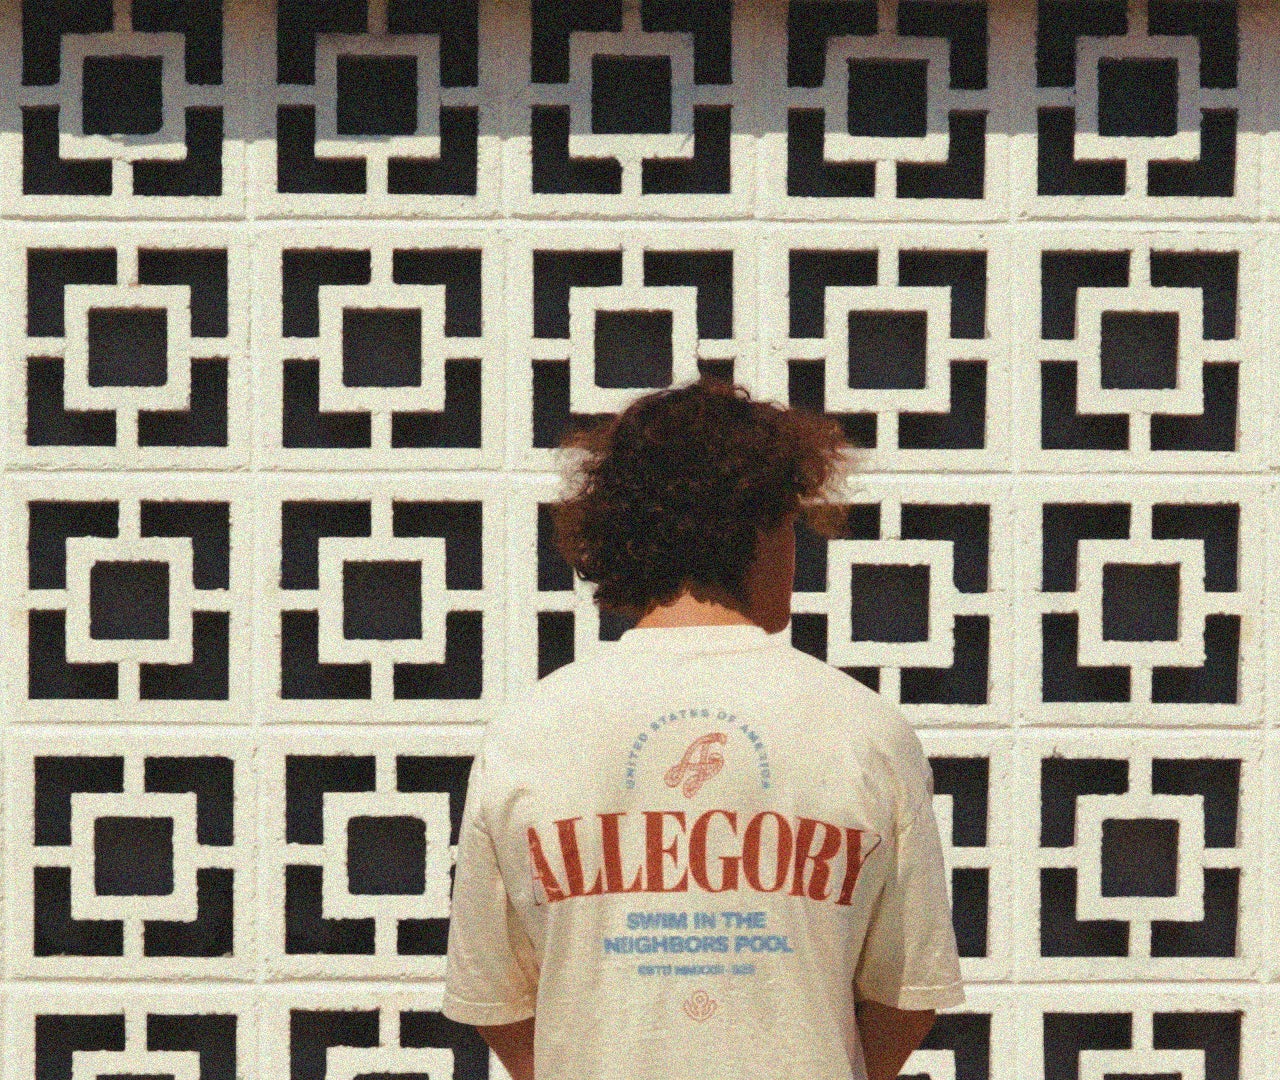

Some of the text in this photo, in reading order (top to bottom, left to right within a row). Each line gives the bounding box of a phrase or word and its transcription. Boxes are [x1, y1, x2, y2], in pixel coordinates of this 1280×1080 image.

[527, 809, 882, 906] ALLEGORY
[627, 911, 767, 930] SWIM IN THE
[603, 936, 795, 954] NEIGHBORS POOL
